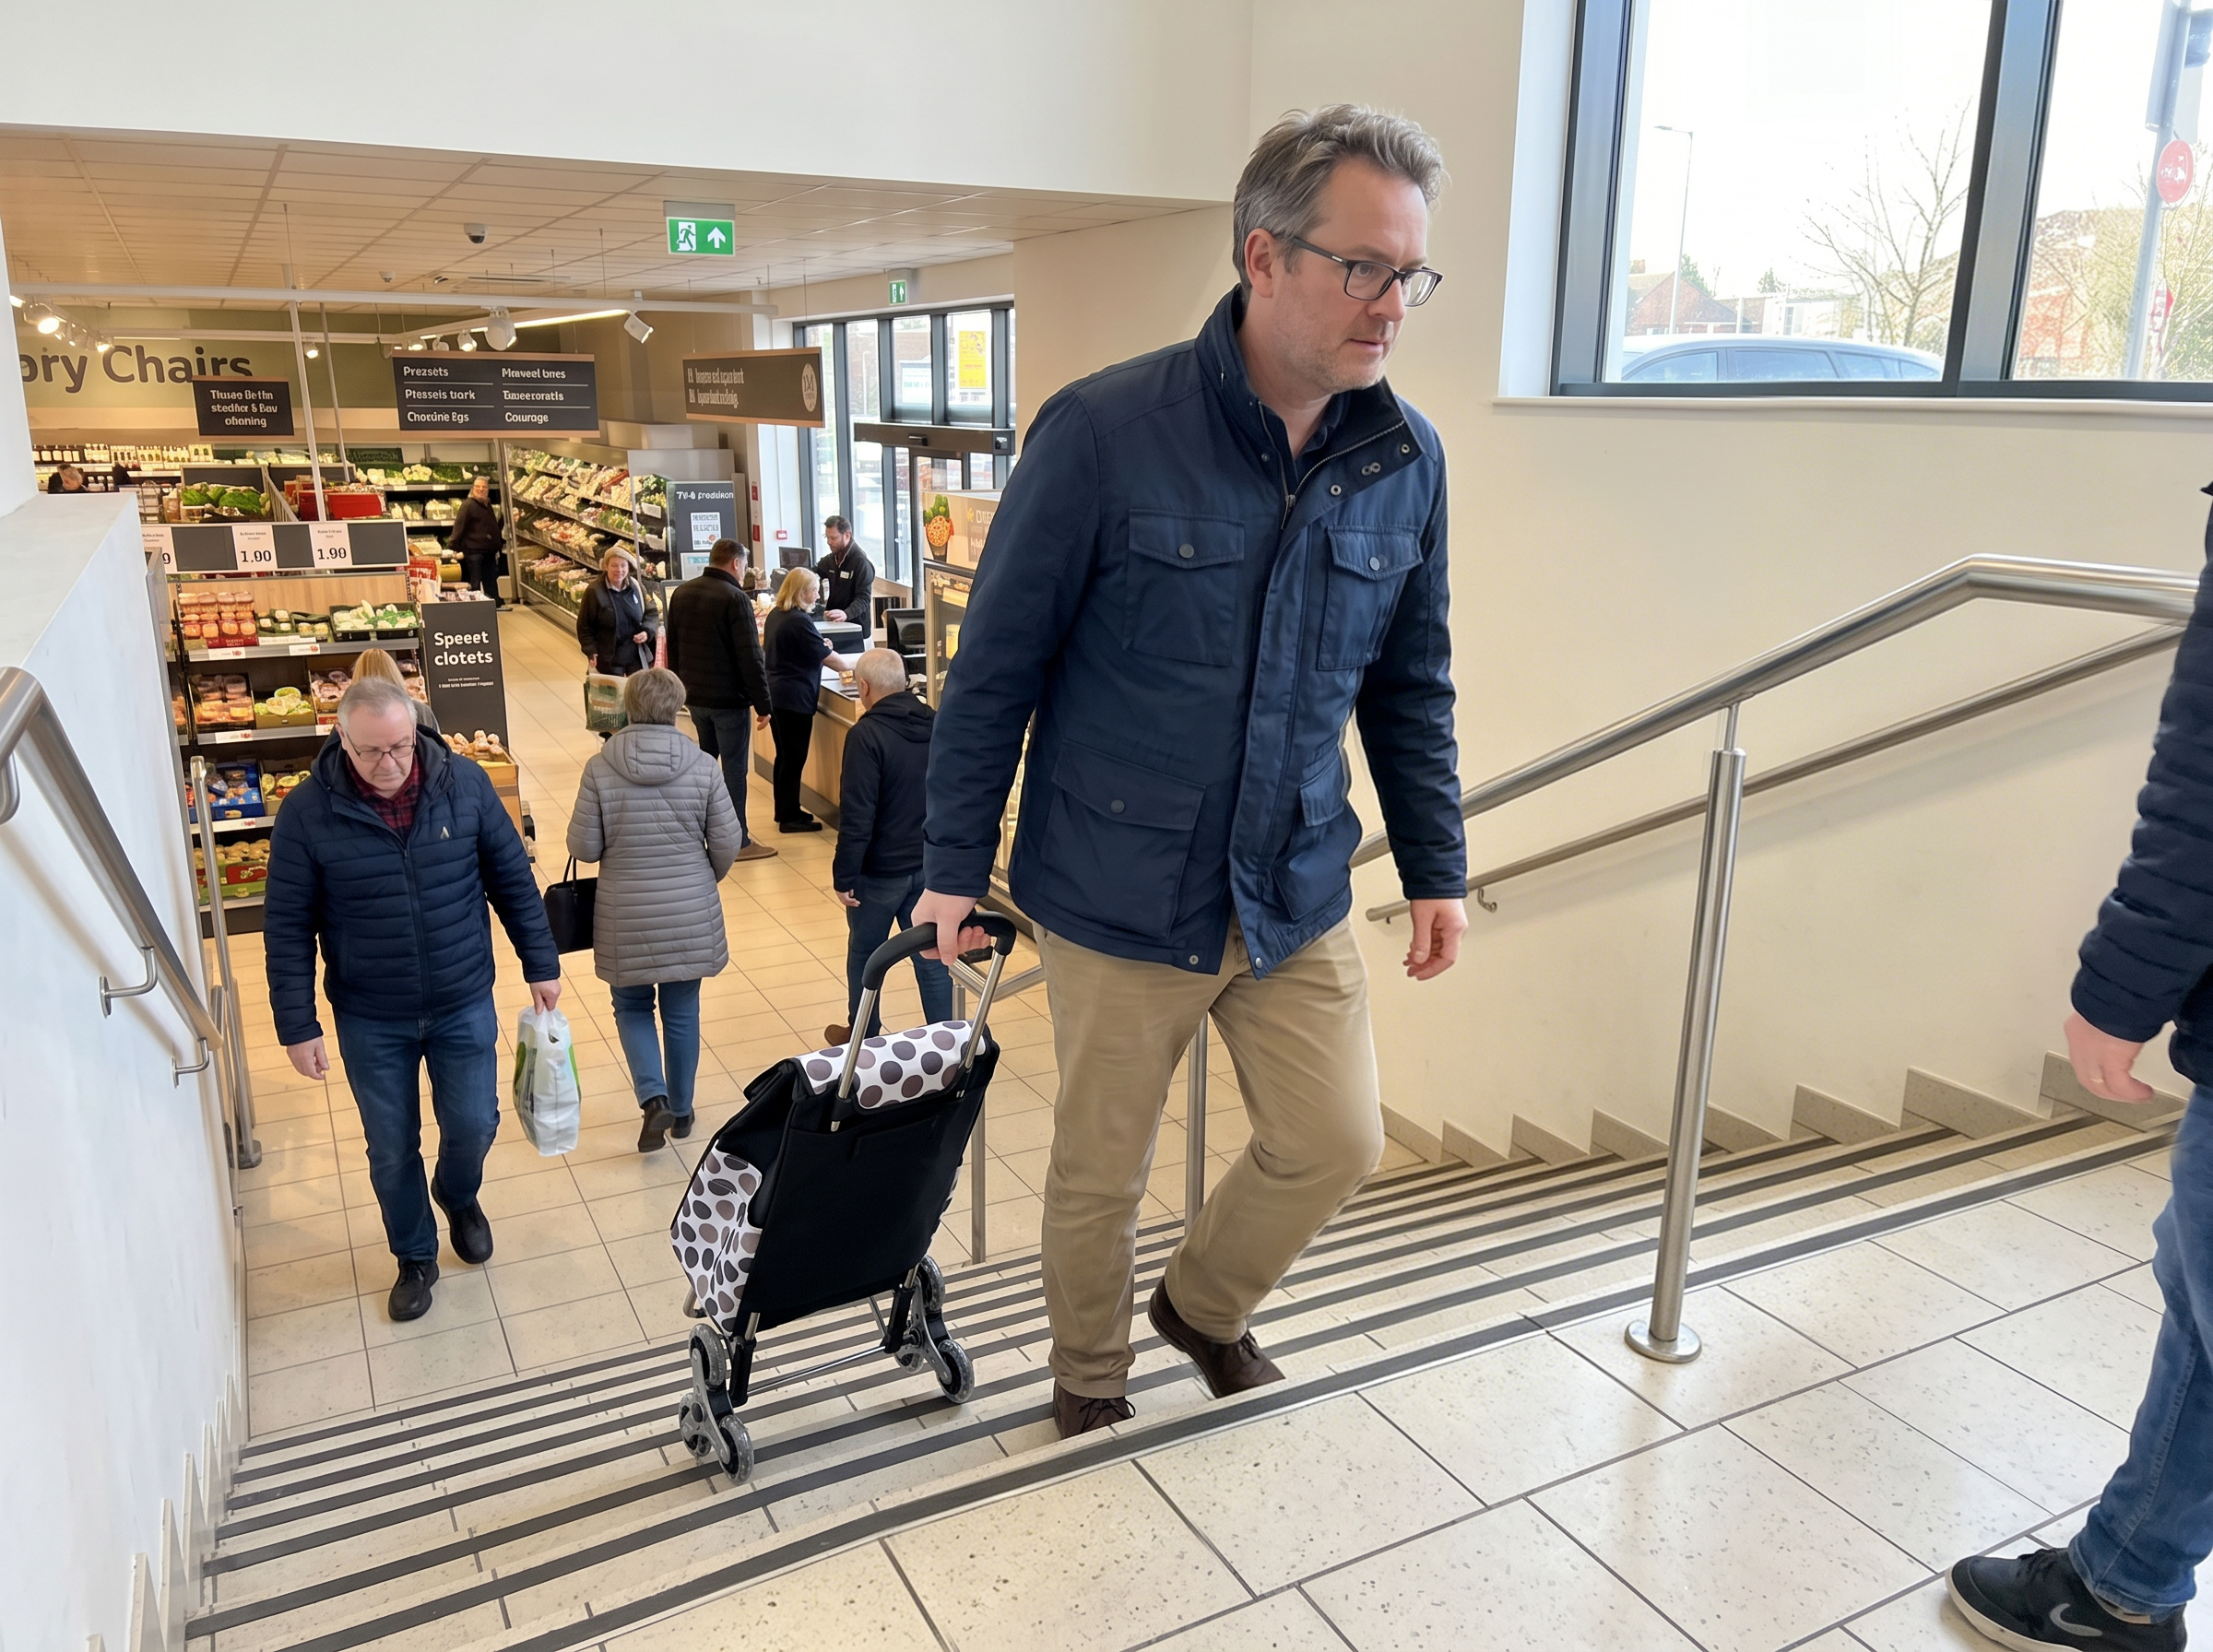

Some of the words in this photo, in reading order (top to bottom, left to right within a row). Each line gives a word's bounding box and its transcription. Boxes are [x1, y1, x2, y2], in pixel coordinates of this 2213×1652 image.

[102, 345, 254, 383] Chairs
[434, 631, 490, 649] Speeet
[434, 651, 493, 666] clotets
